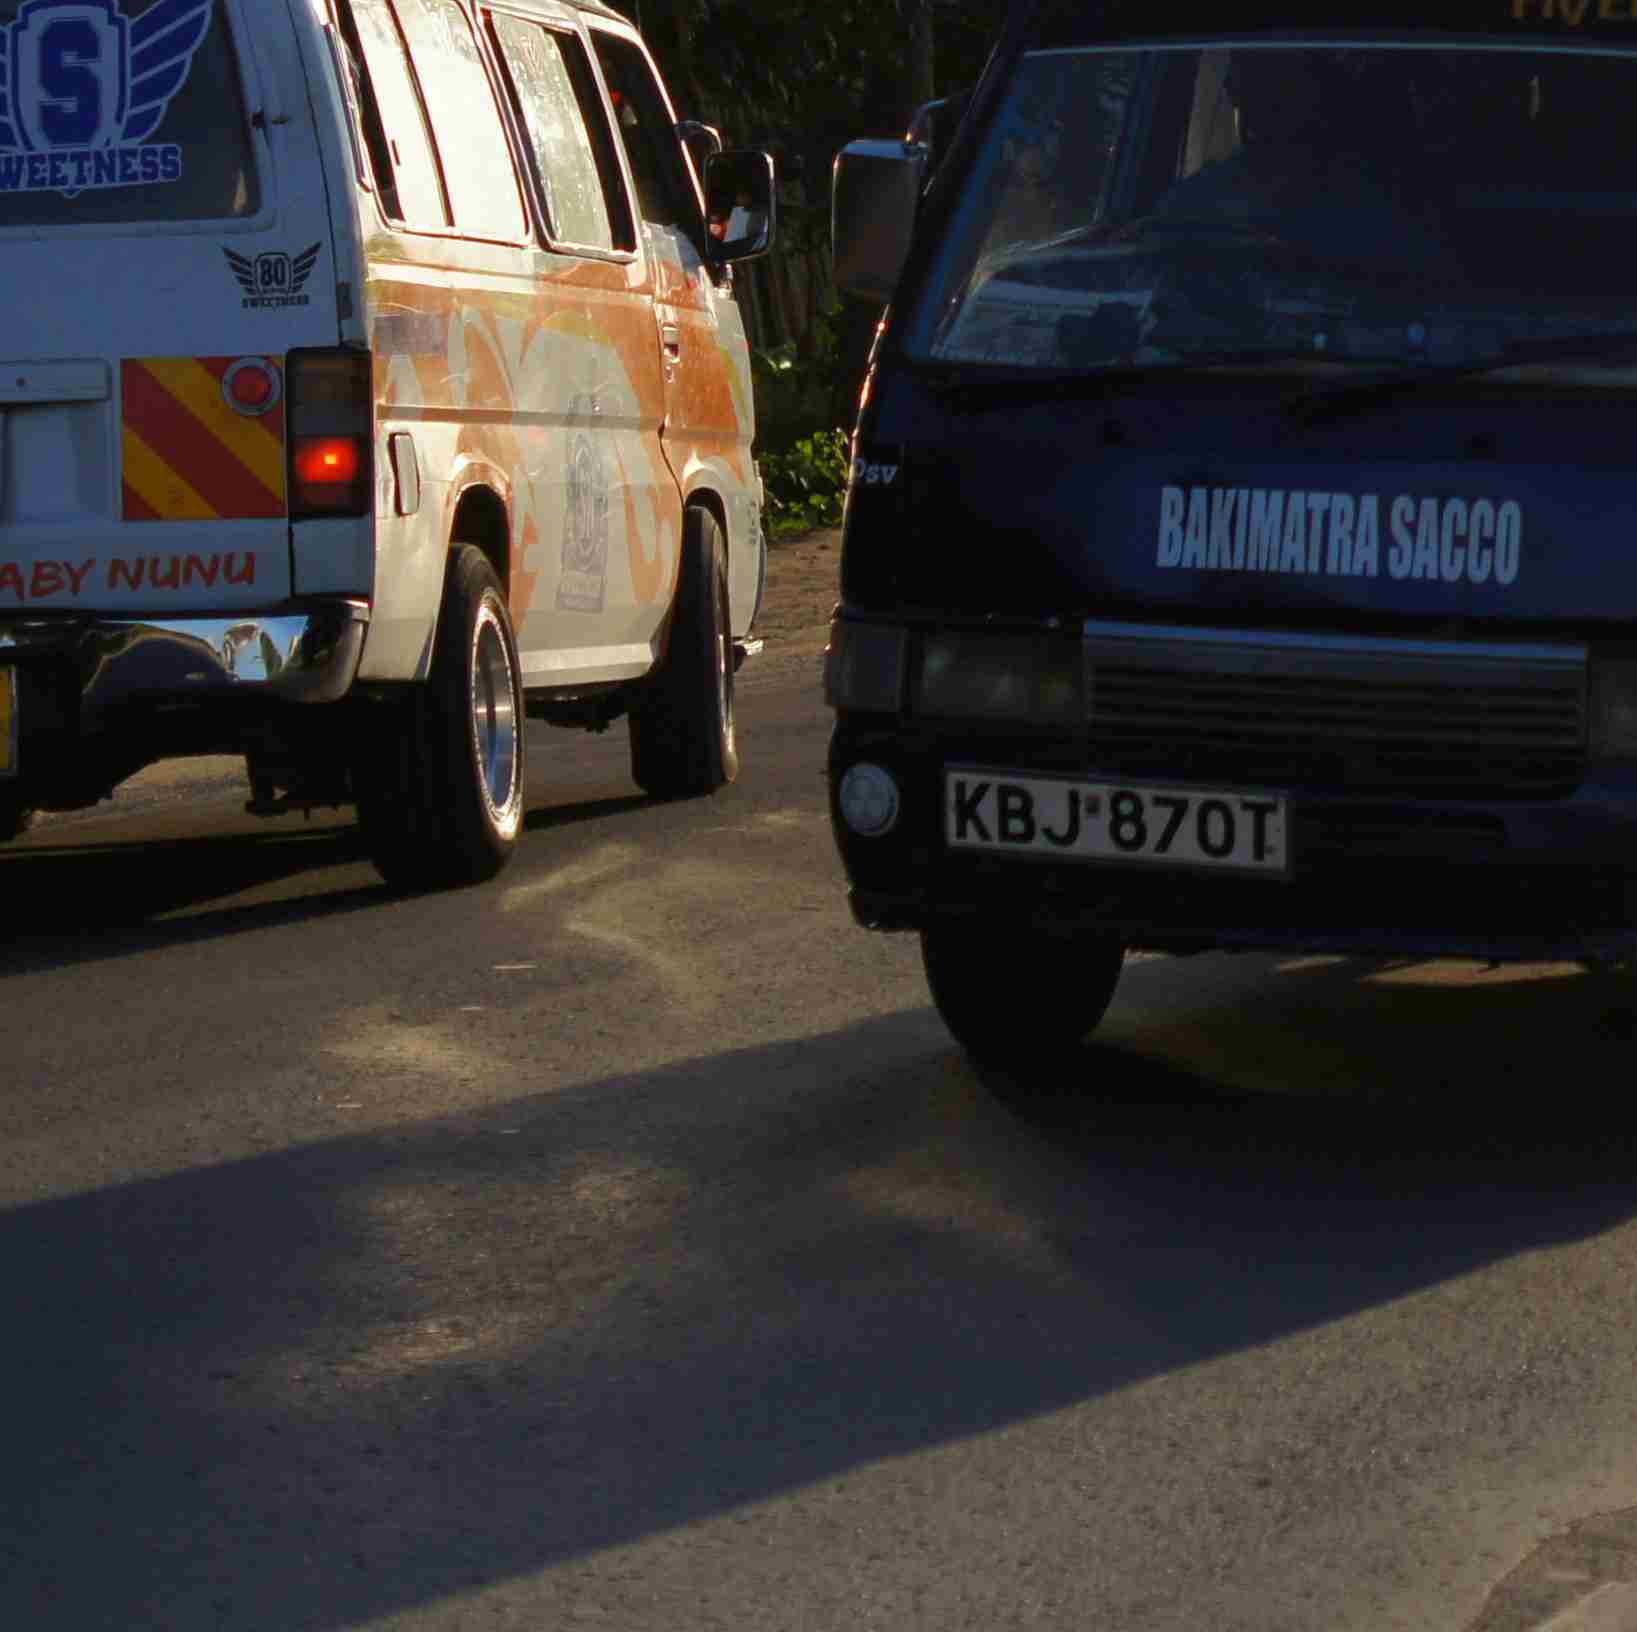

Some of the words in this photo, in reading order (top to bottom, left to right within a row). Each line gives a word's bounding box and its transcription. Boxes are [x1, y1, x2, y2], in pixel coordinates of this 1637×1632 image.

[1156, 485, 1380, 577] BAKIMATRA
[1388, 494, 1522, 585] SACCO
[108, 551, 257, 592] NUNU
